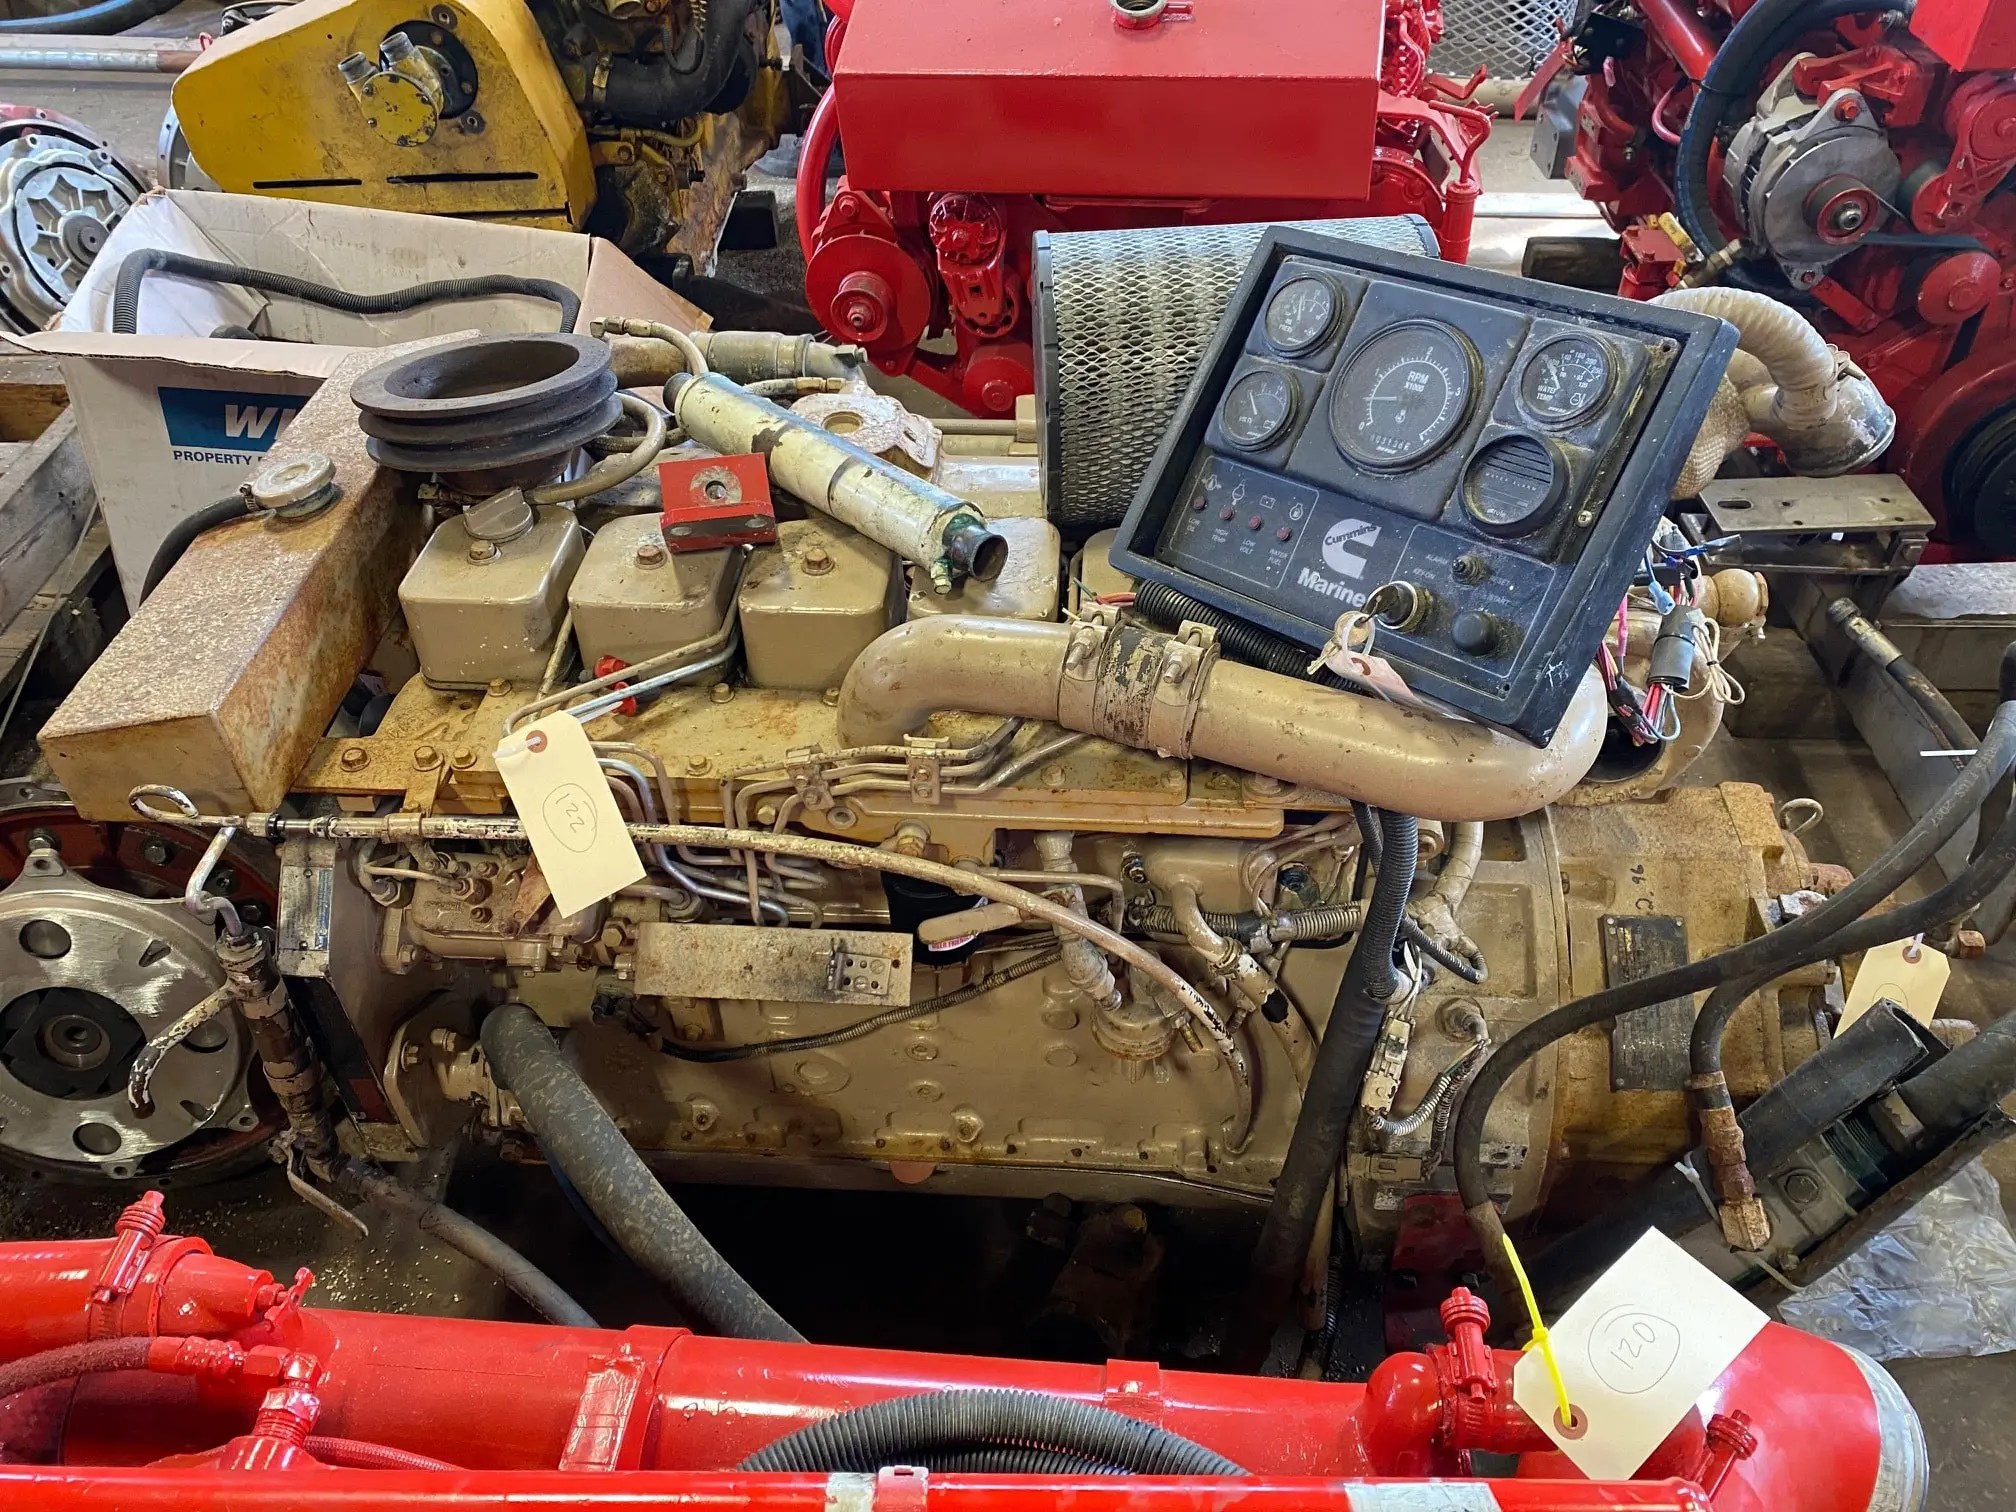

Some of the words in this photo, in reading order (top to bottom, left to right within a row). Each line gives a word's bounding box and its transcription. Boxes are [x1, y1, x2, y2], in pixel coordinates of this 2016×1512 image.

[1407, 370, 1429, 385] RPM
[173, 450, 253, 466] PROPERTY
[1242, 538, 1257, 548] LOW
[1325, 523, 1377, 546] Cummins
[1297, 567, 1367, 608] Marine
[1610, 1321, 1656, 1371] 120
